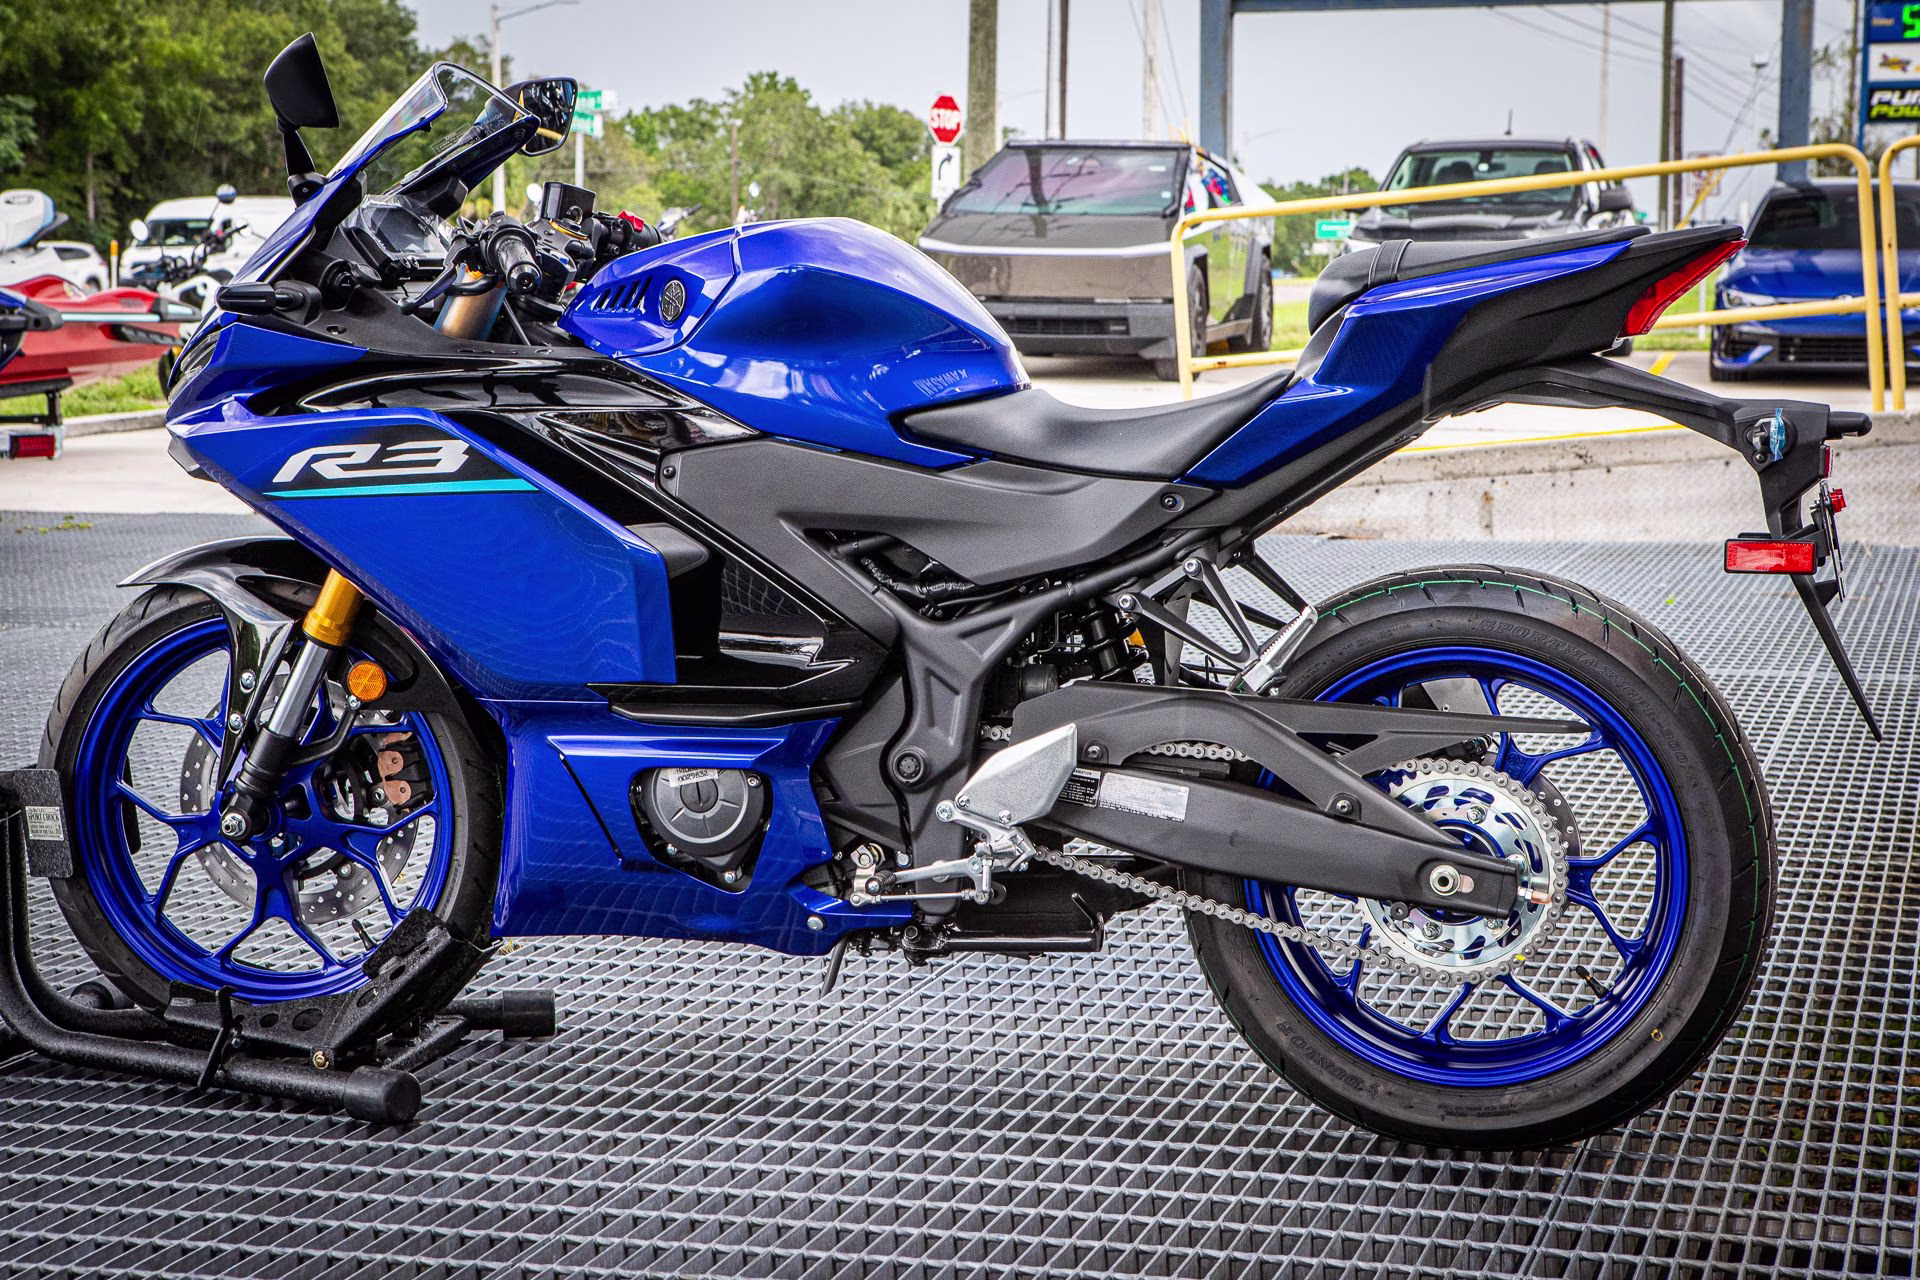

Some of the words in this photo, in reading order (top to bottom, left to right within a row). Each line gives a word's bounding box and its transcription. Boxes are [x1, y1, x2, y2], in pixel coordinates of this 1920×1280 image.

[931, 108, 961, 130] STOP
[273, 440, 469, 482] R3
[1476, 619, 1617, 679] SPORTMAX
